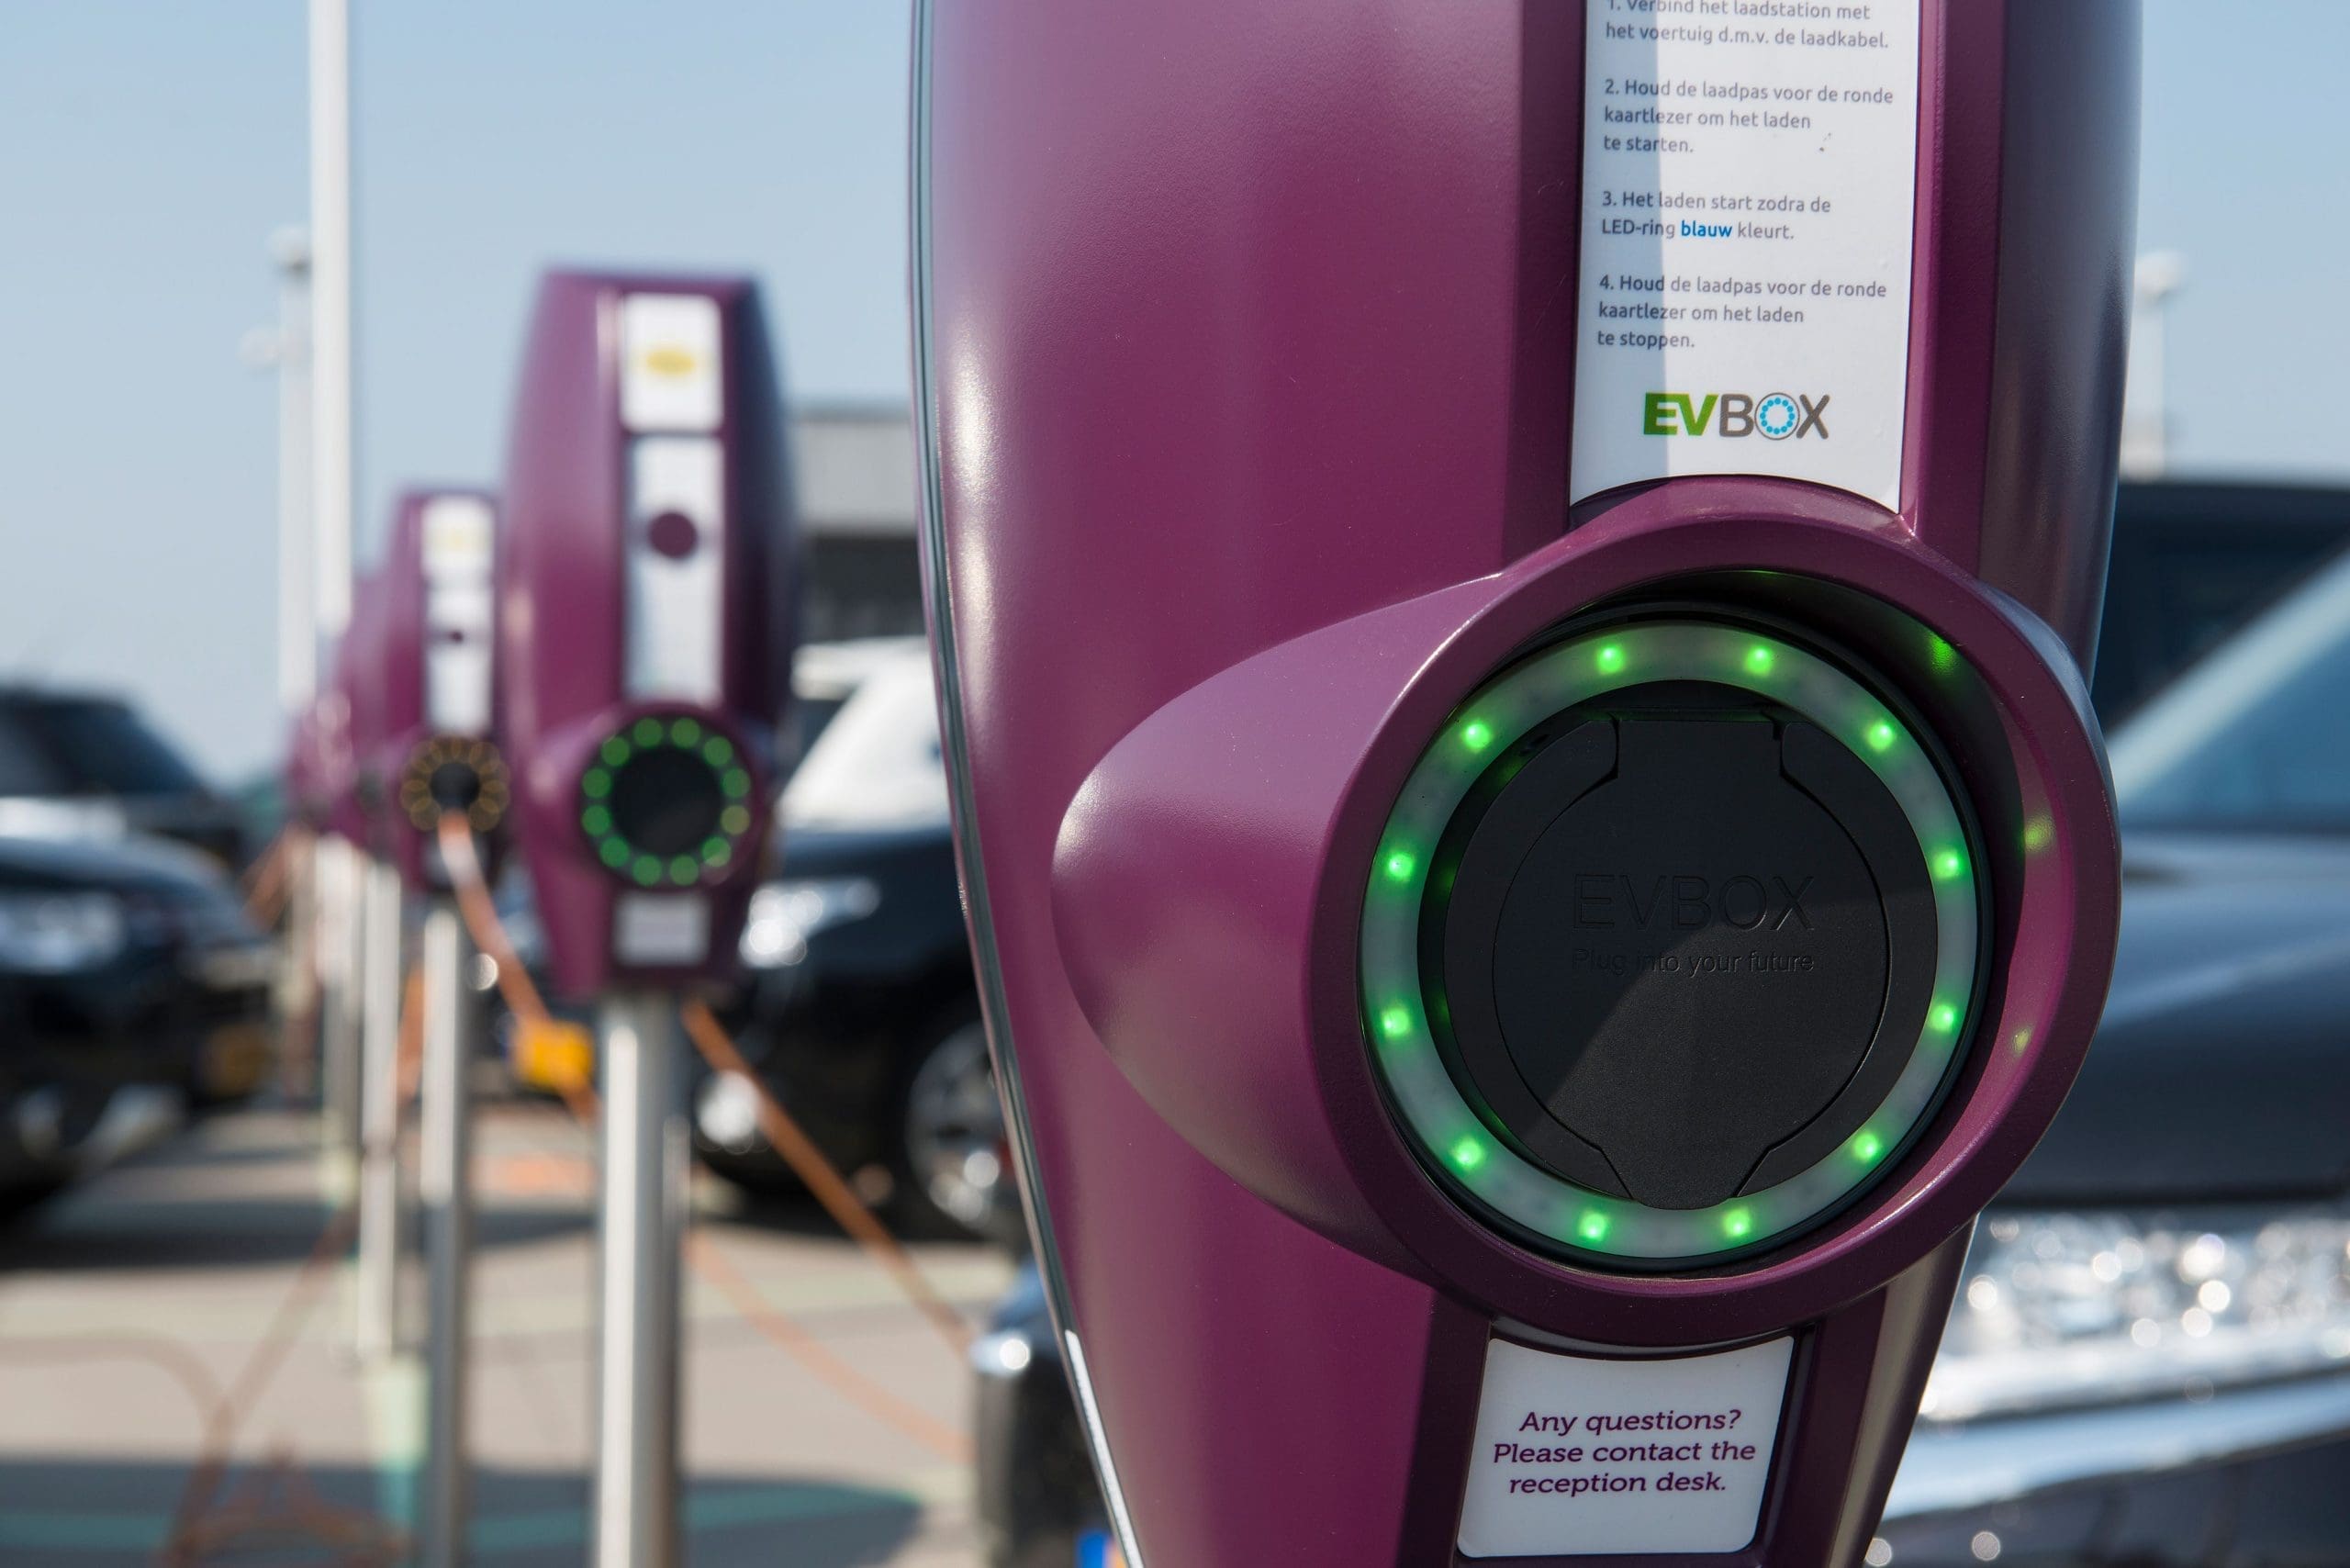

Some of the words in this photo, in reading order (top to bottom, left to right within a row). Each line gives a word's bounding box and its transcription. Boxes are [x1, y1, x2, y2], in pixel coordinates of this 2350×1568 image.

[1608, 0, 1621, 11] 1.
[1626, 0, 1694, 14] Verbind
[1700, 0, 1728, 15] het
[1733, 0, 1830, 18] laadstation
[1837, 6, 1870, 20] met
[1606, 23, 1635, 39] het
[1639, 26, 1712, 44] voertuig
[1718, 27, 1769, 44] d.m.v.
[1774, 28, 1796, 45] de
[1801, 28, 1888, 48] laadkabel.
[1606, 79, 1619, 95] 2.
[1626, 80, 1670, 96] Houd
[1676, 82, 1697, 97] de
[1703, 83, 1768, 102] laadpas
[1774, 86, 1812, 101] voor
[1818, 85, 1838, 102] de
[1843, 86, 1893, 104] ronde
[1605, 106, 1692, 125] kaartlezer
[1698, 112, 1724, 126] om
[1729, 110, 1759, 127] het
[1764, 111, 1810, 129] laden
[1604, 135, 1621, 151] te
[1627, 136, 1693, 153] starten.
[1602, 191, 1617, 207] 3.
[1623, 192, 1654, 207] Het
[1660, 193, 1706, 209] laden
[1711, 196, 1752, 210] start
[1757, 195, 1805, 212] zodra
[1810, 196, 1830, 213] de
[1602, 219, 1675, 239] LED-ring
[1681, 220, 1732, 238] blauw
[1738, 222, 1795, 240] kleurt.
[1600, 274, 1614, 290] 4.
[1619, 275, 1664, 291] Houd
[1671, 276, 1690, 292] de
[1697, 276, 1762, 297] laadpas
[1767, 281, 1805, 296] voor
[1811, 279, 1831, 296] de
[1838, 281, 1886, 297] ronde
[1599, 302, 1685, 320] kaartlezer
[1692, 308, 1718, 320] om
[1723, 305, 1751, 321] het
[1757, 306, 1803, 323] laden
[1597, 331, 1615, 345] te
[1620, 332, 1695, 351] stoppen.
[1643, 392, 1830, 441] EVBOX
[1573, 874, 1815, 931] EVBOX
[1688, 953, 1743, 978] your
[1749, 950, 1815, 972] future
[1519, 1412, 1577, 1436] Any
[1585, 1409, 1741, 1435] questions?
[1494, 1444, 1583, 1463] Please
[1593, 1442, 1702, 1462] contact
[1711, 1441, 1756, 1461] the
[1509, 1473, 1647, 1496] reception
[1656, 1472, 1727, 1491] desk.
